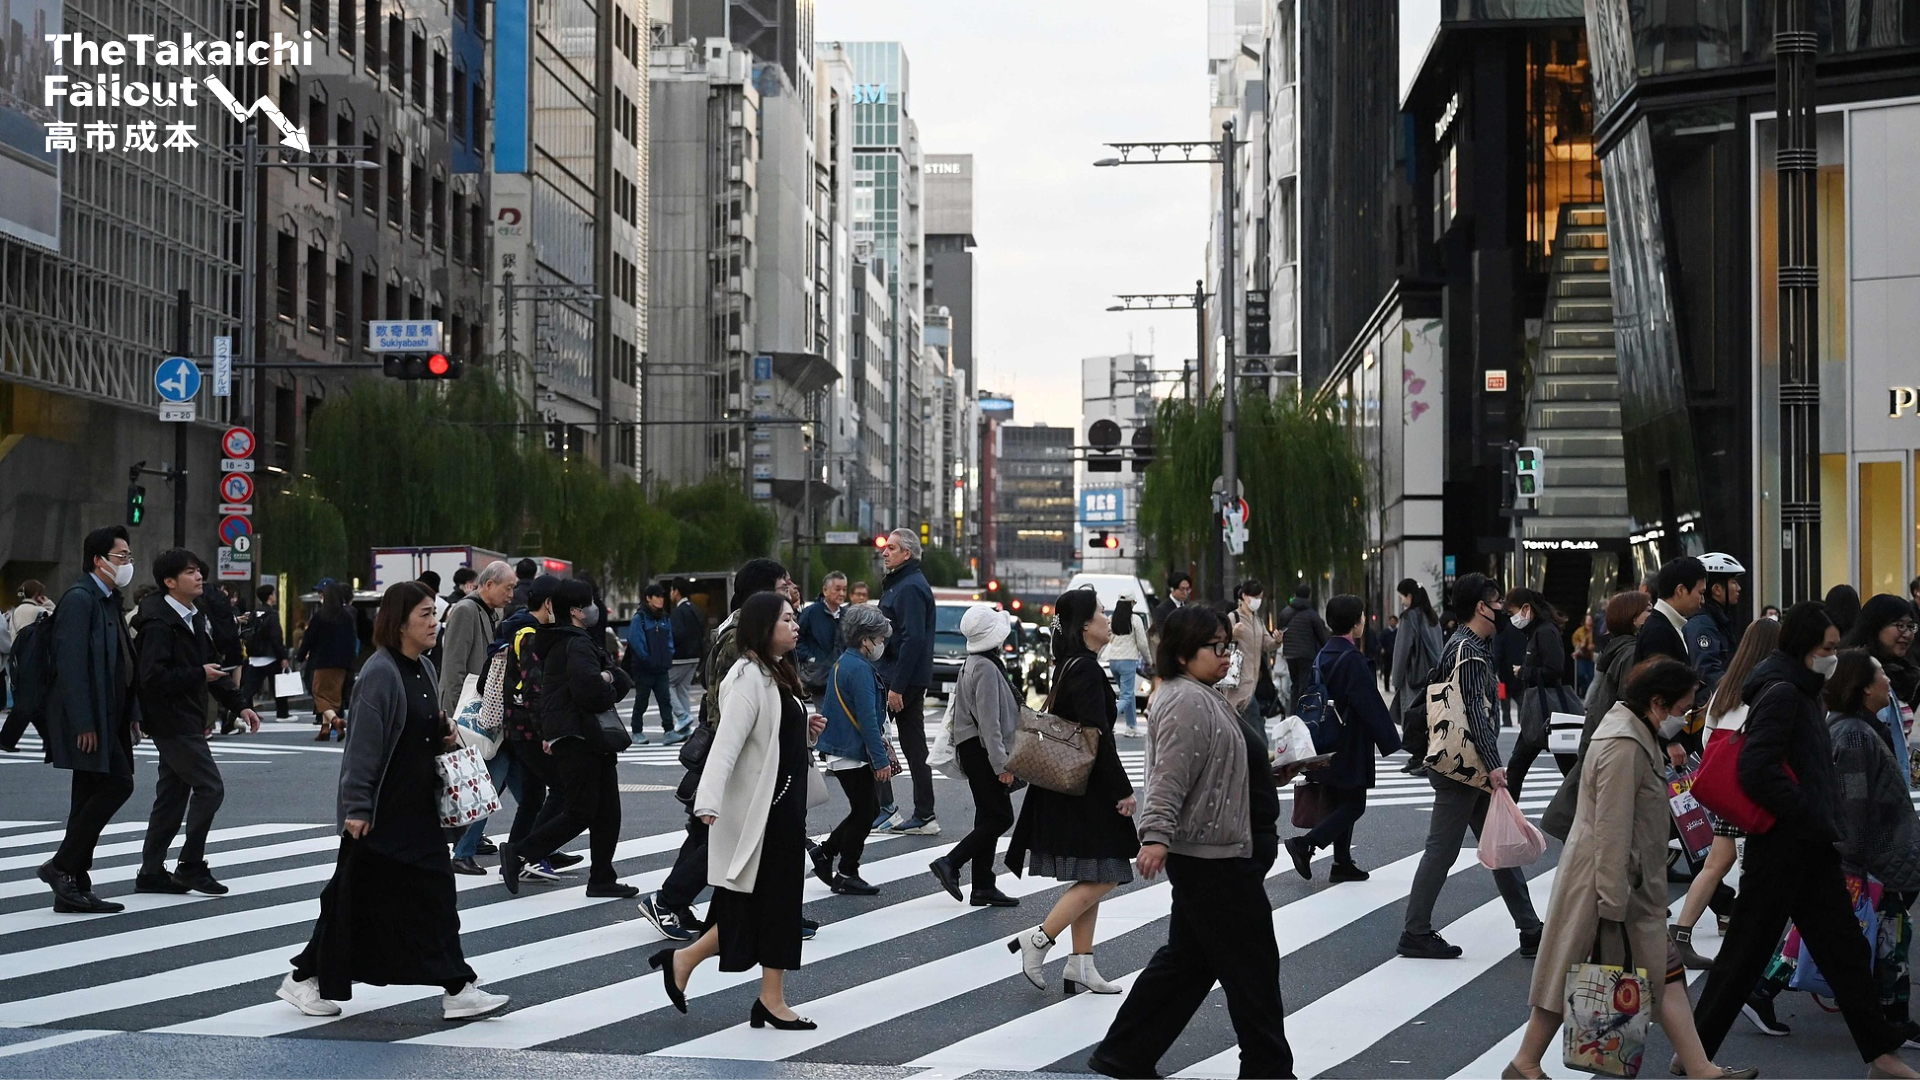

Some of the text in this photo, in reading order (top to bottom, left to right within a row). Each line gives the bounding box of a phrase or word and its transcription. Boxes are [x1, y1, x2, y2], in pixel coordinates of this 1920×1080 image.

[376, 324, 433, 337] 数寄屋橋
[380, 338, 429, 349] Sukiyabashi
[218, 340, 228, 393] スクランブル式
[1888, 386, 1920, 418] P
[1522, 541, 1598, 550] TOKYU PLAZA
